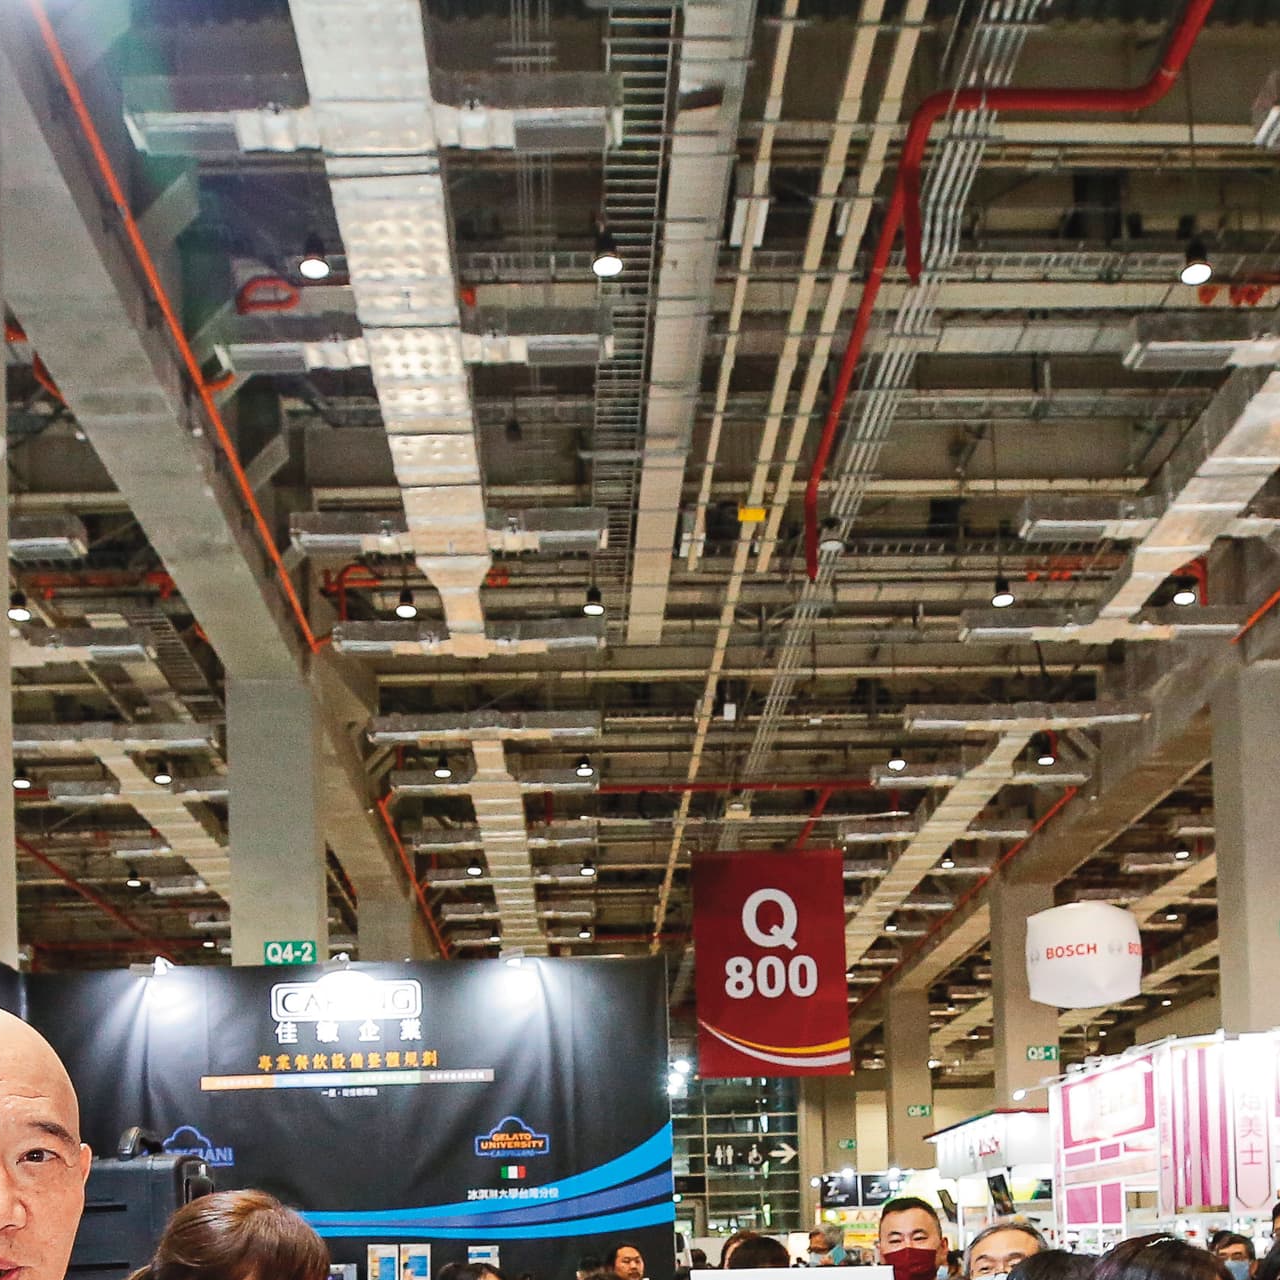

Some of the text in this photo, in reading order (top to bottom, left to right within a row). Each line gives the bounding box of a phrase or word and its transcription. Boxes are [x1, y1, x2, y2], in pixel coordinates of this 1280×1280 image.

[741, 887, 799, 951] Q
[265, 941, 314, 965] Q4-2
[1046, 943, 1098, 960] BOSCH
[724, 954, 819, 999] 800
[480, 1140, 545, 1151] UNIVERSITY
[491, 1132, 533, 1142] GELATO
